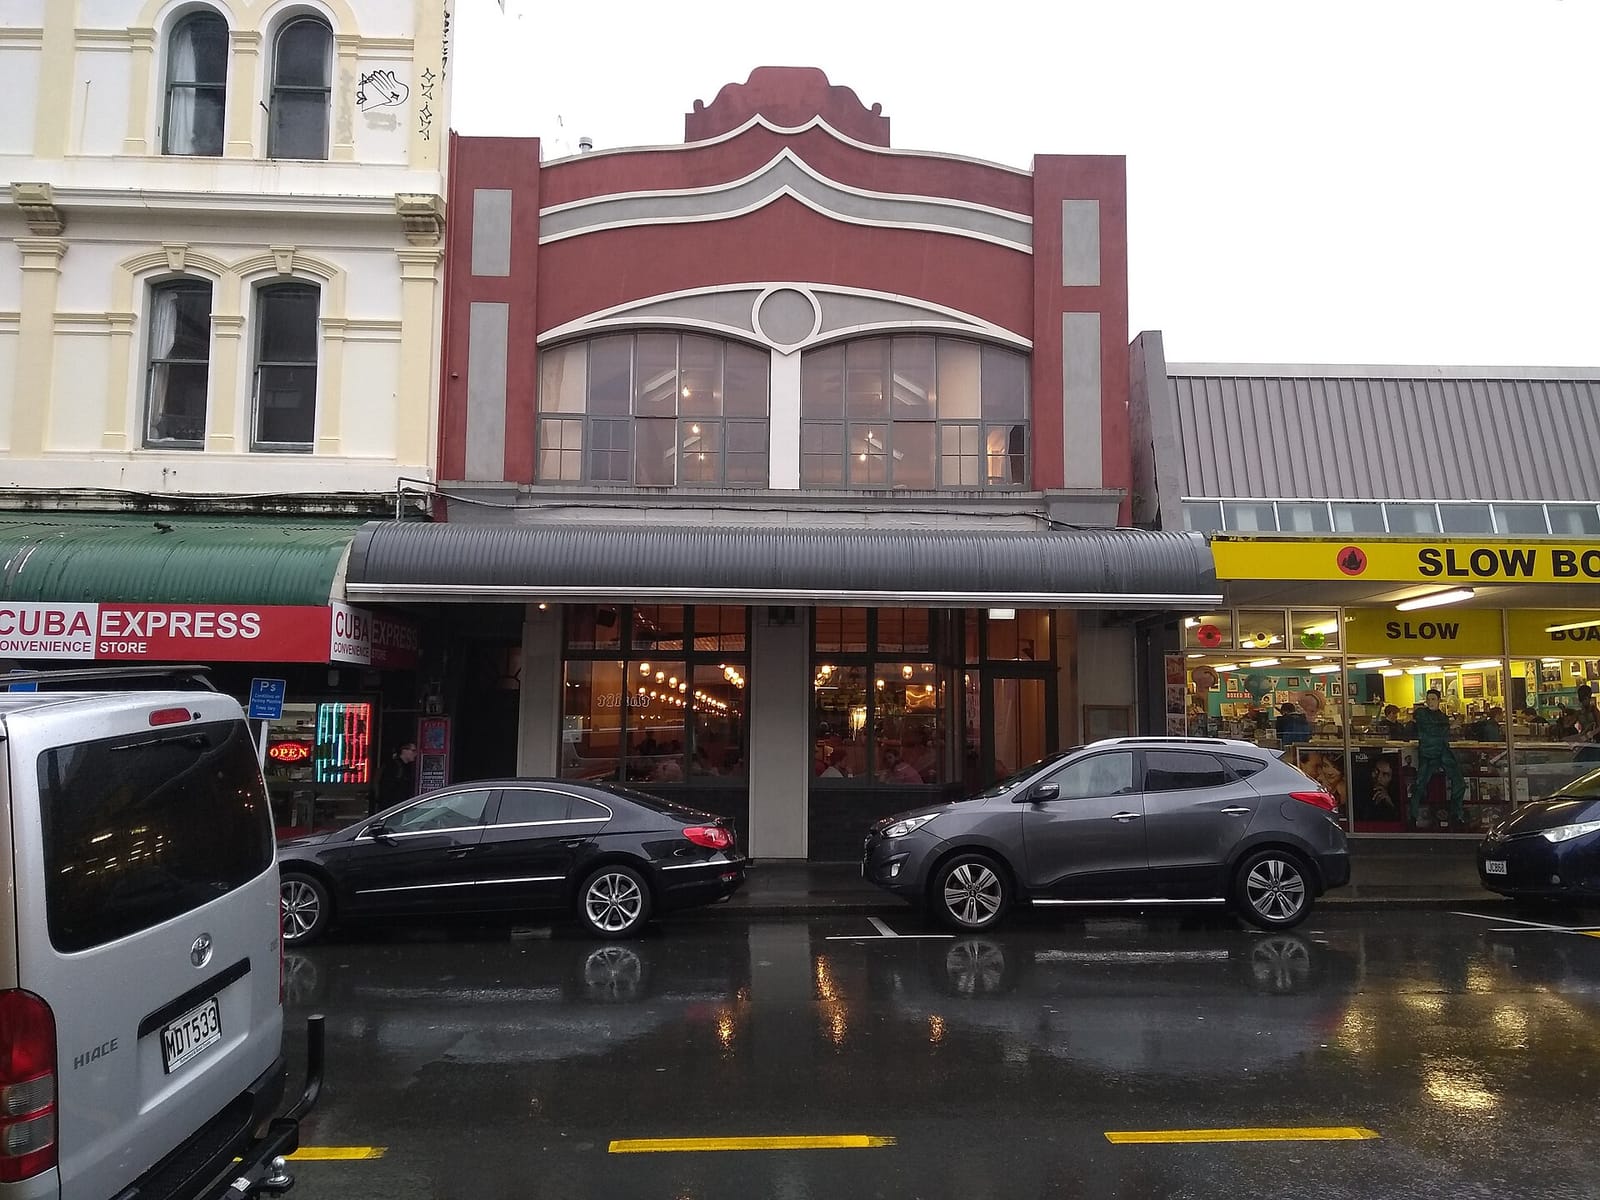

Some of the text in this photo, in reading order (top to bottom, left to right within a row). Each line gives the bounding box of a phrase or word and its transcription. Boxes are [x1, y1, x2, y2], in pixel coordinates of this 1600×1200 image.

[1417, 548, 1600, 577] SLOW BO
[0, 608, 261, 639] CUBA EXPRESS
[335, 610, 370, 643] CUBA
[1385, 621, 1460, 640] SLOW
[99, 641, 147, 654] STORE
[333, 641, 370, 658] CONVENIENCE
[269, 747, 309, 758] OPEN
[165, 1006, 218, 1062] MDT533
[73, 1037, 119, 1070] HIACE
